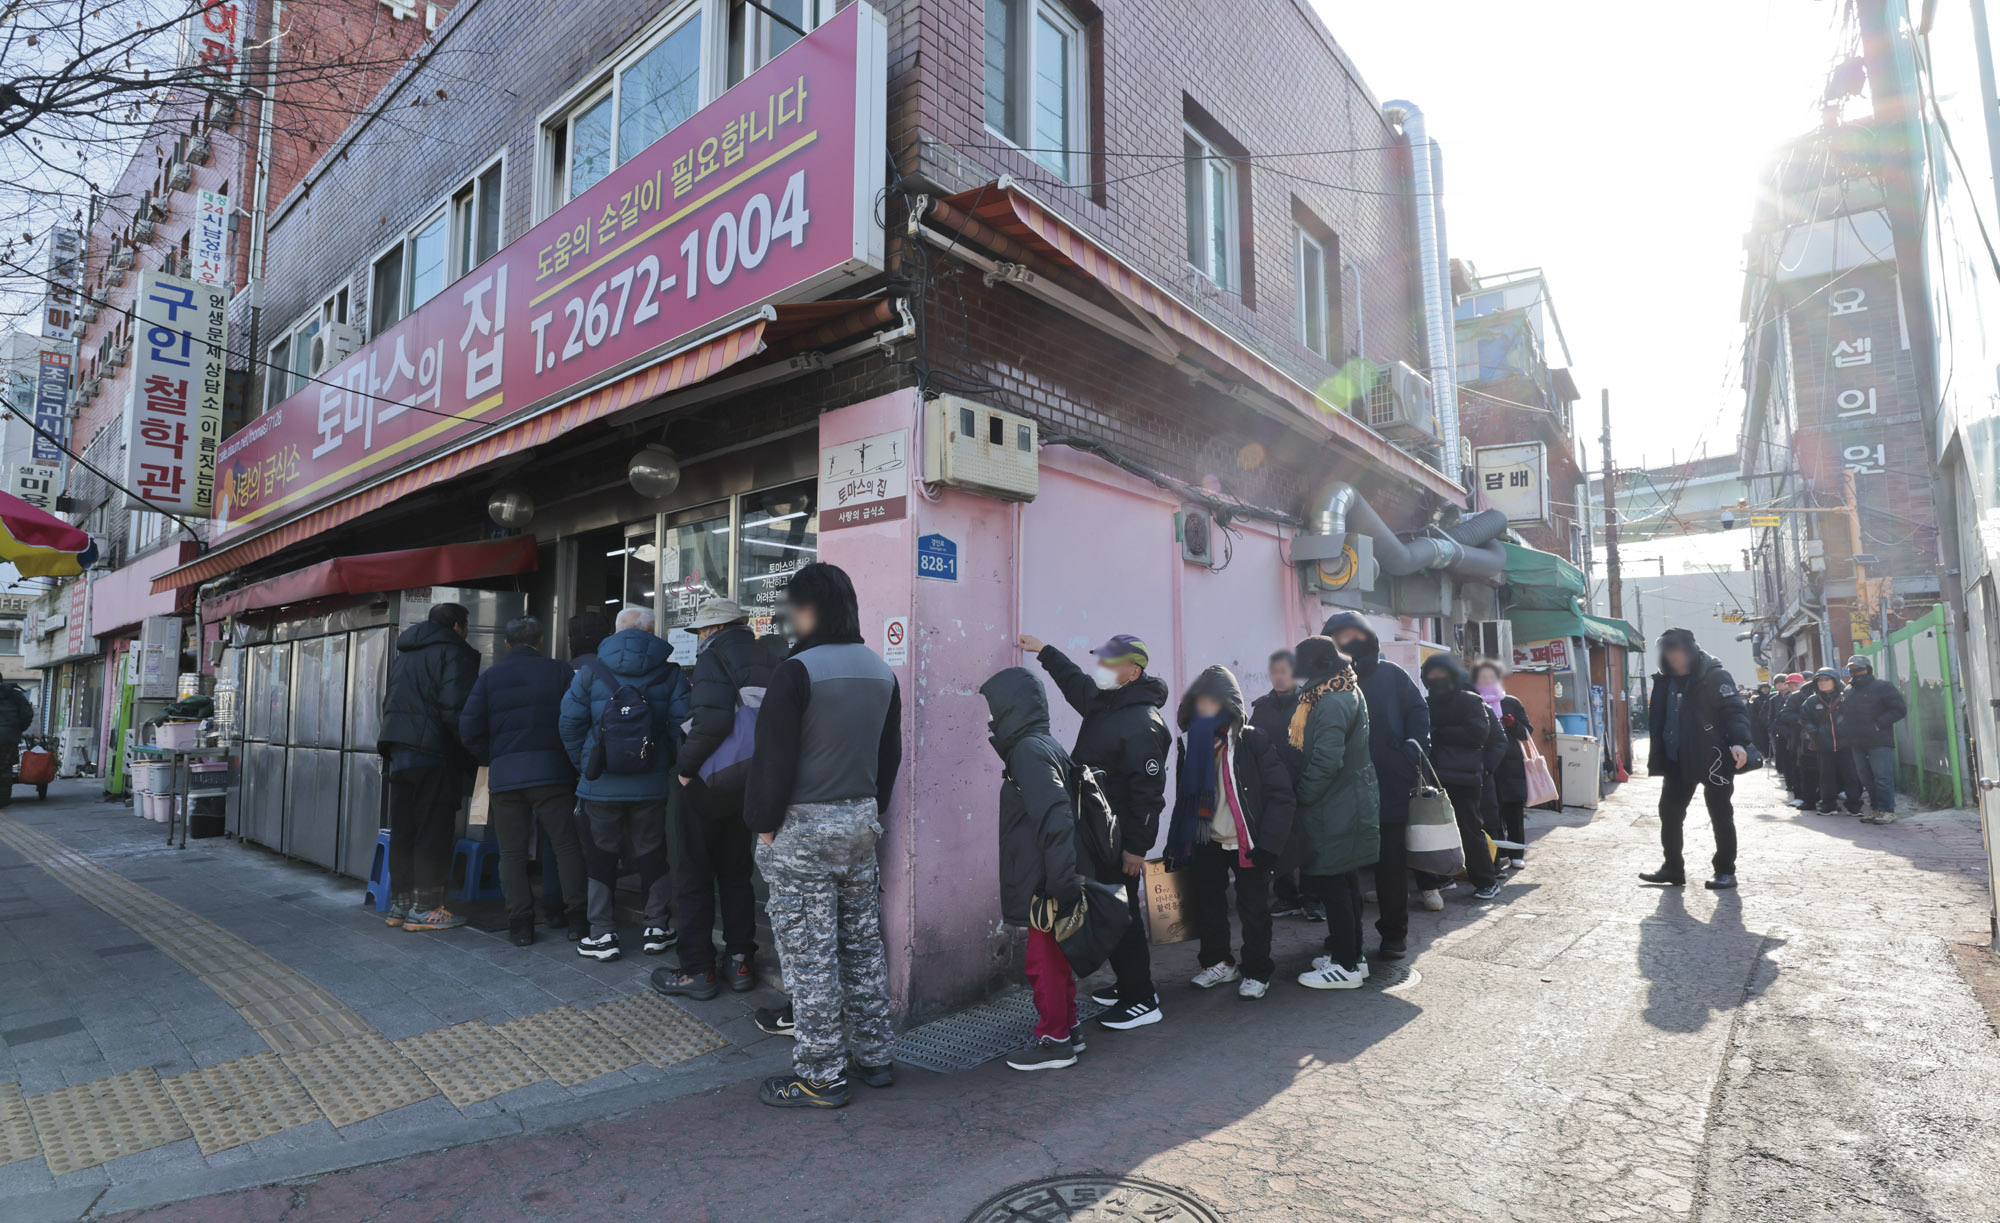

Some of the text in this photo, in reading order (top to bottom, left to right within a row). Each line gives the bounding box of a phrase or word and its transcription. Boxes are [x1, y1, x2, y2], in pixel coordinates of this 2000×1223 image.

[535, 75, 808, 283] 도움의 손길이 필요합니다
[311, 263, 509, 460] 토마스의 집
[232, 443, 300, 512] 사랑의 급식소
[1485, 470, 1529, 491] 담배
[838, 478, 888, 505] 토마스의 집
[838, 505, 886, 523] 사랑의 급식소
[769, 559, 795, 573] 토마스의
[920, 555, 954, 574] 828-1
[677, 580, 713, 612] 토마스
